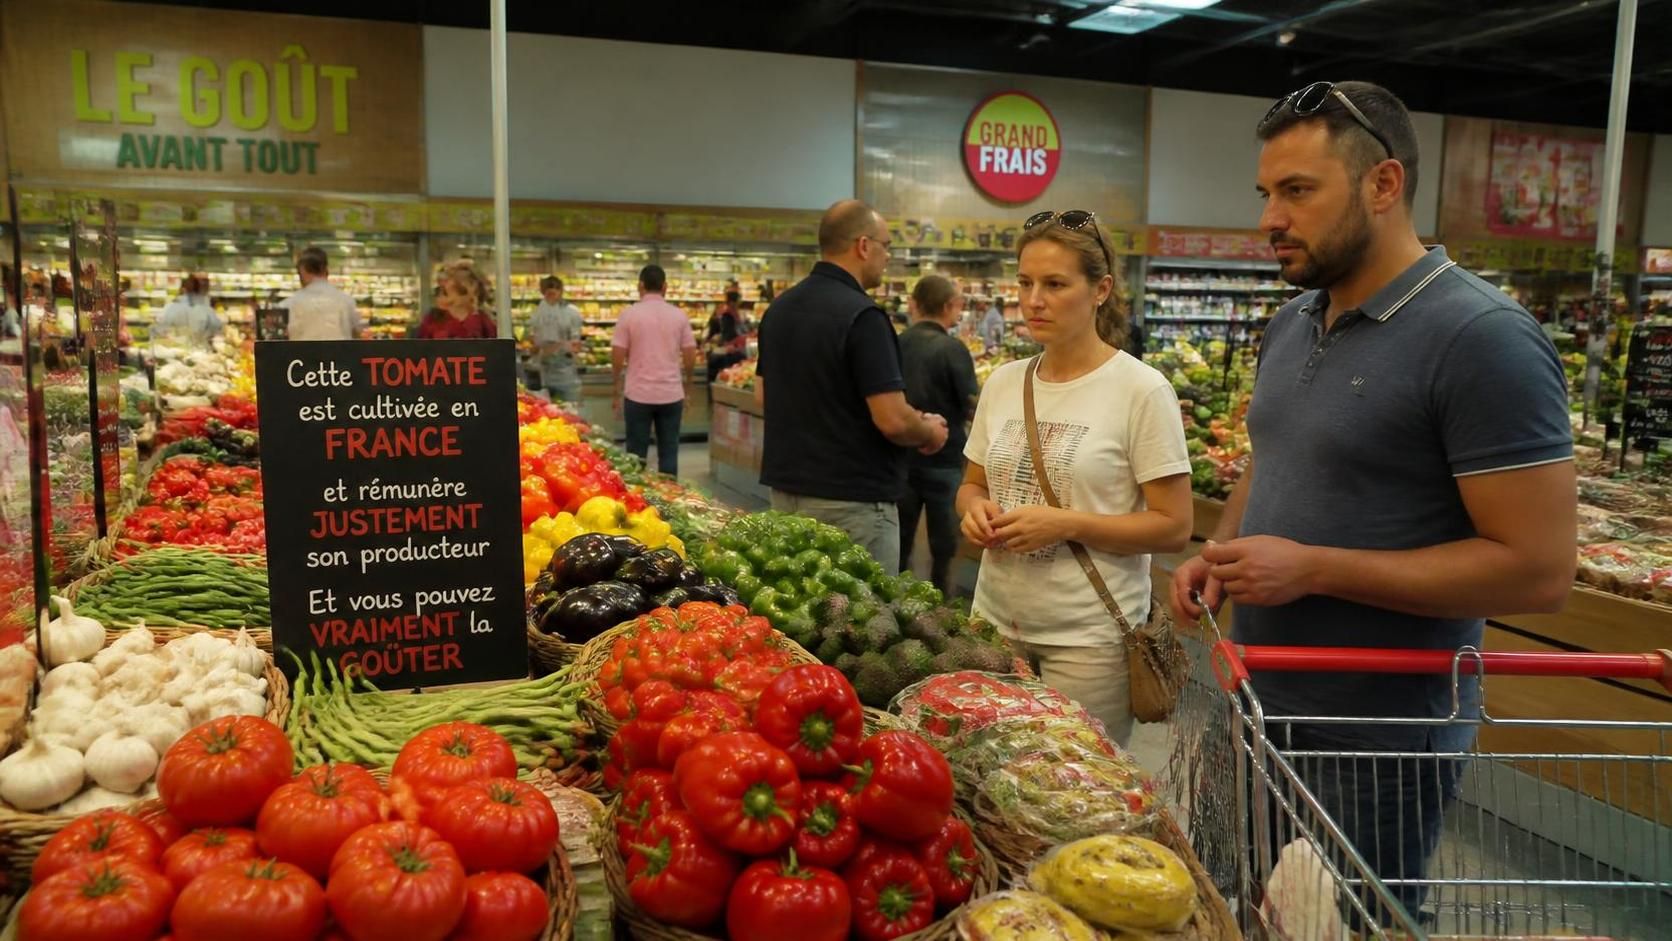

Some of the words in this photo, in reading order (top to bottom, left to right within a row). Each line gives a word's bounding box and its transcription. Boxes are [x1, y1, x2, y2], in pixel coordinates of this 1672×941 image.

[70, 49, 155, 126] LE
[179, 44, 358, 134] GOÛT
[980, 121, 1047, 148] GRAND
[116, 133, 228, 172] AVANT
[236, 138, 320, 175] TOUT
[979, 146, 1047, 176] FRAIS
[286, 359, 353, 388] Cette
[361, 356, 487, 387] TOMATE
[299, 397, 337, 422] est
[451, 401, 480, 418] en
[325, 425, 463, 460] FRANCE
[323, 478, 348, 503] et
[310, 503, 483, 539] JUSTEMENT
[305, 550, 349, 568] son
[360, 535, 490, 574] producteur
[308, 588, 337, 615] Et
[349, 592, 403, 612] vous
[415, 586, 496, 618] pouvez
[309, 611, 461, 648] VRAIMENT
[470, 610, 494, 634] la
